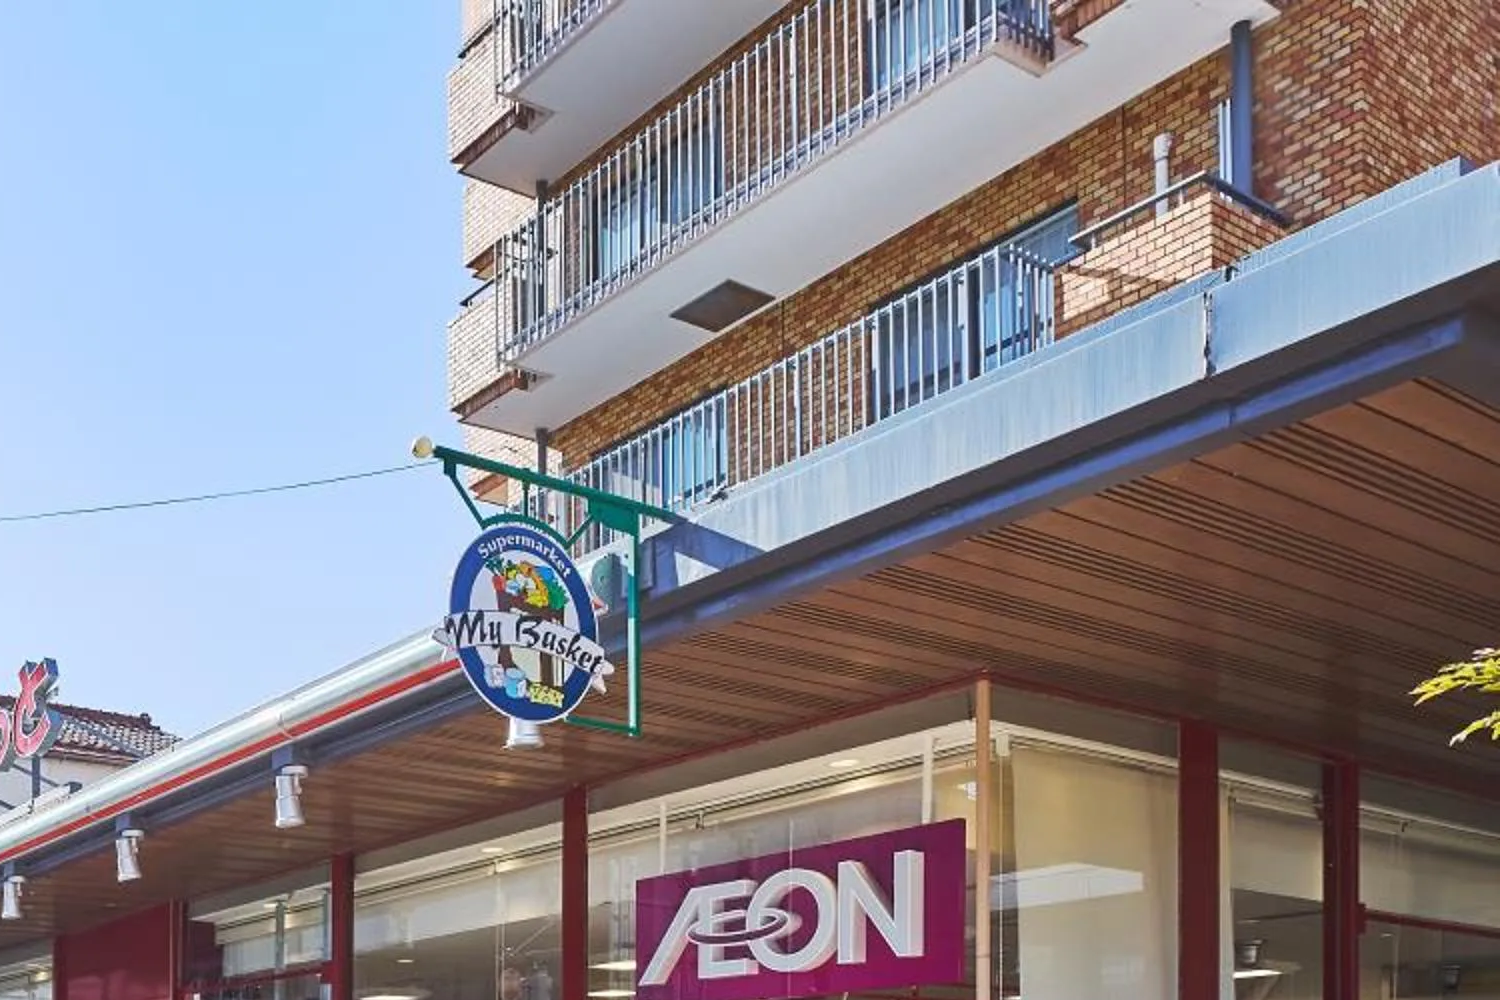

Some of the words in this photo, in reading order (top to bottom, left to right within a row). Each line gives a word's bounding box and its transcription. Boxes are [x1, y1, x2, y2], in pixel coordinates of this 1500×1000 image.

[477, 534, 571, 577] Supermarket
[444, 609, 501, 649] My
[515, 614, 604, 674] Basket
